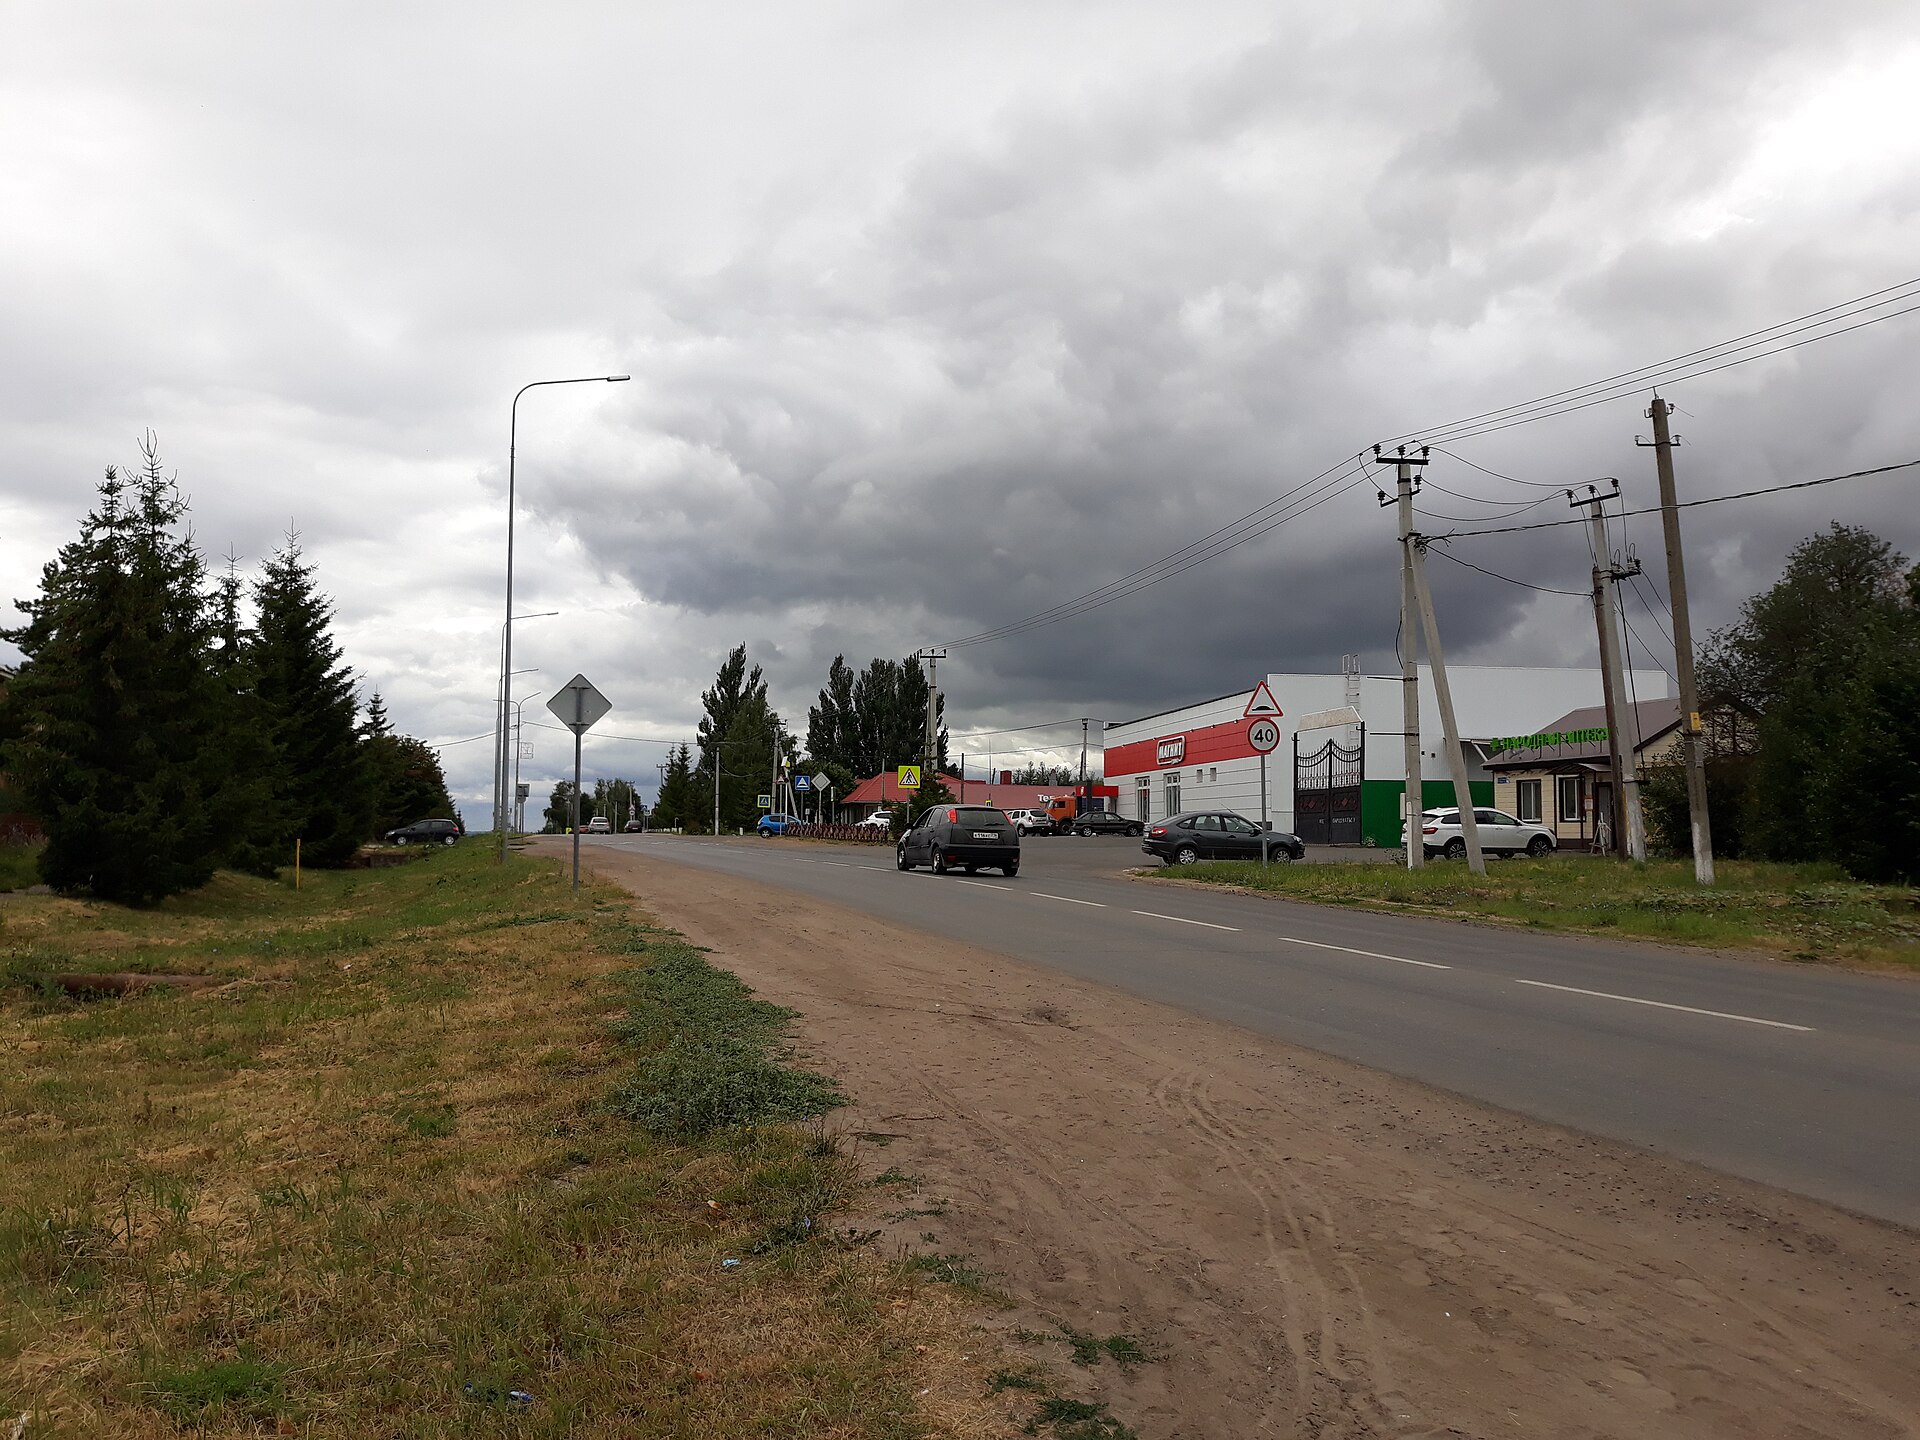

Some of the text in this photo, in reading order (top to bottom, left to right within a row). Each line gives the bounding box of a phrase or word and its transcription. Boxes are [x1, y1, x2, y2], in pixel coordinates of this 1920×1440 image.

[1254, 728, 1274, 743] 40
[1503, 728, 1608, 749] НАРОДНАЯ АПТЕКА
[1159, 742, 1182, 759] МАГНИТ
